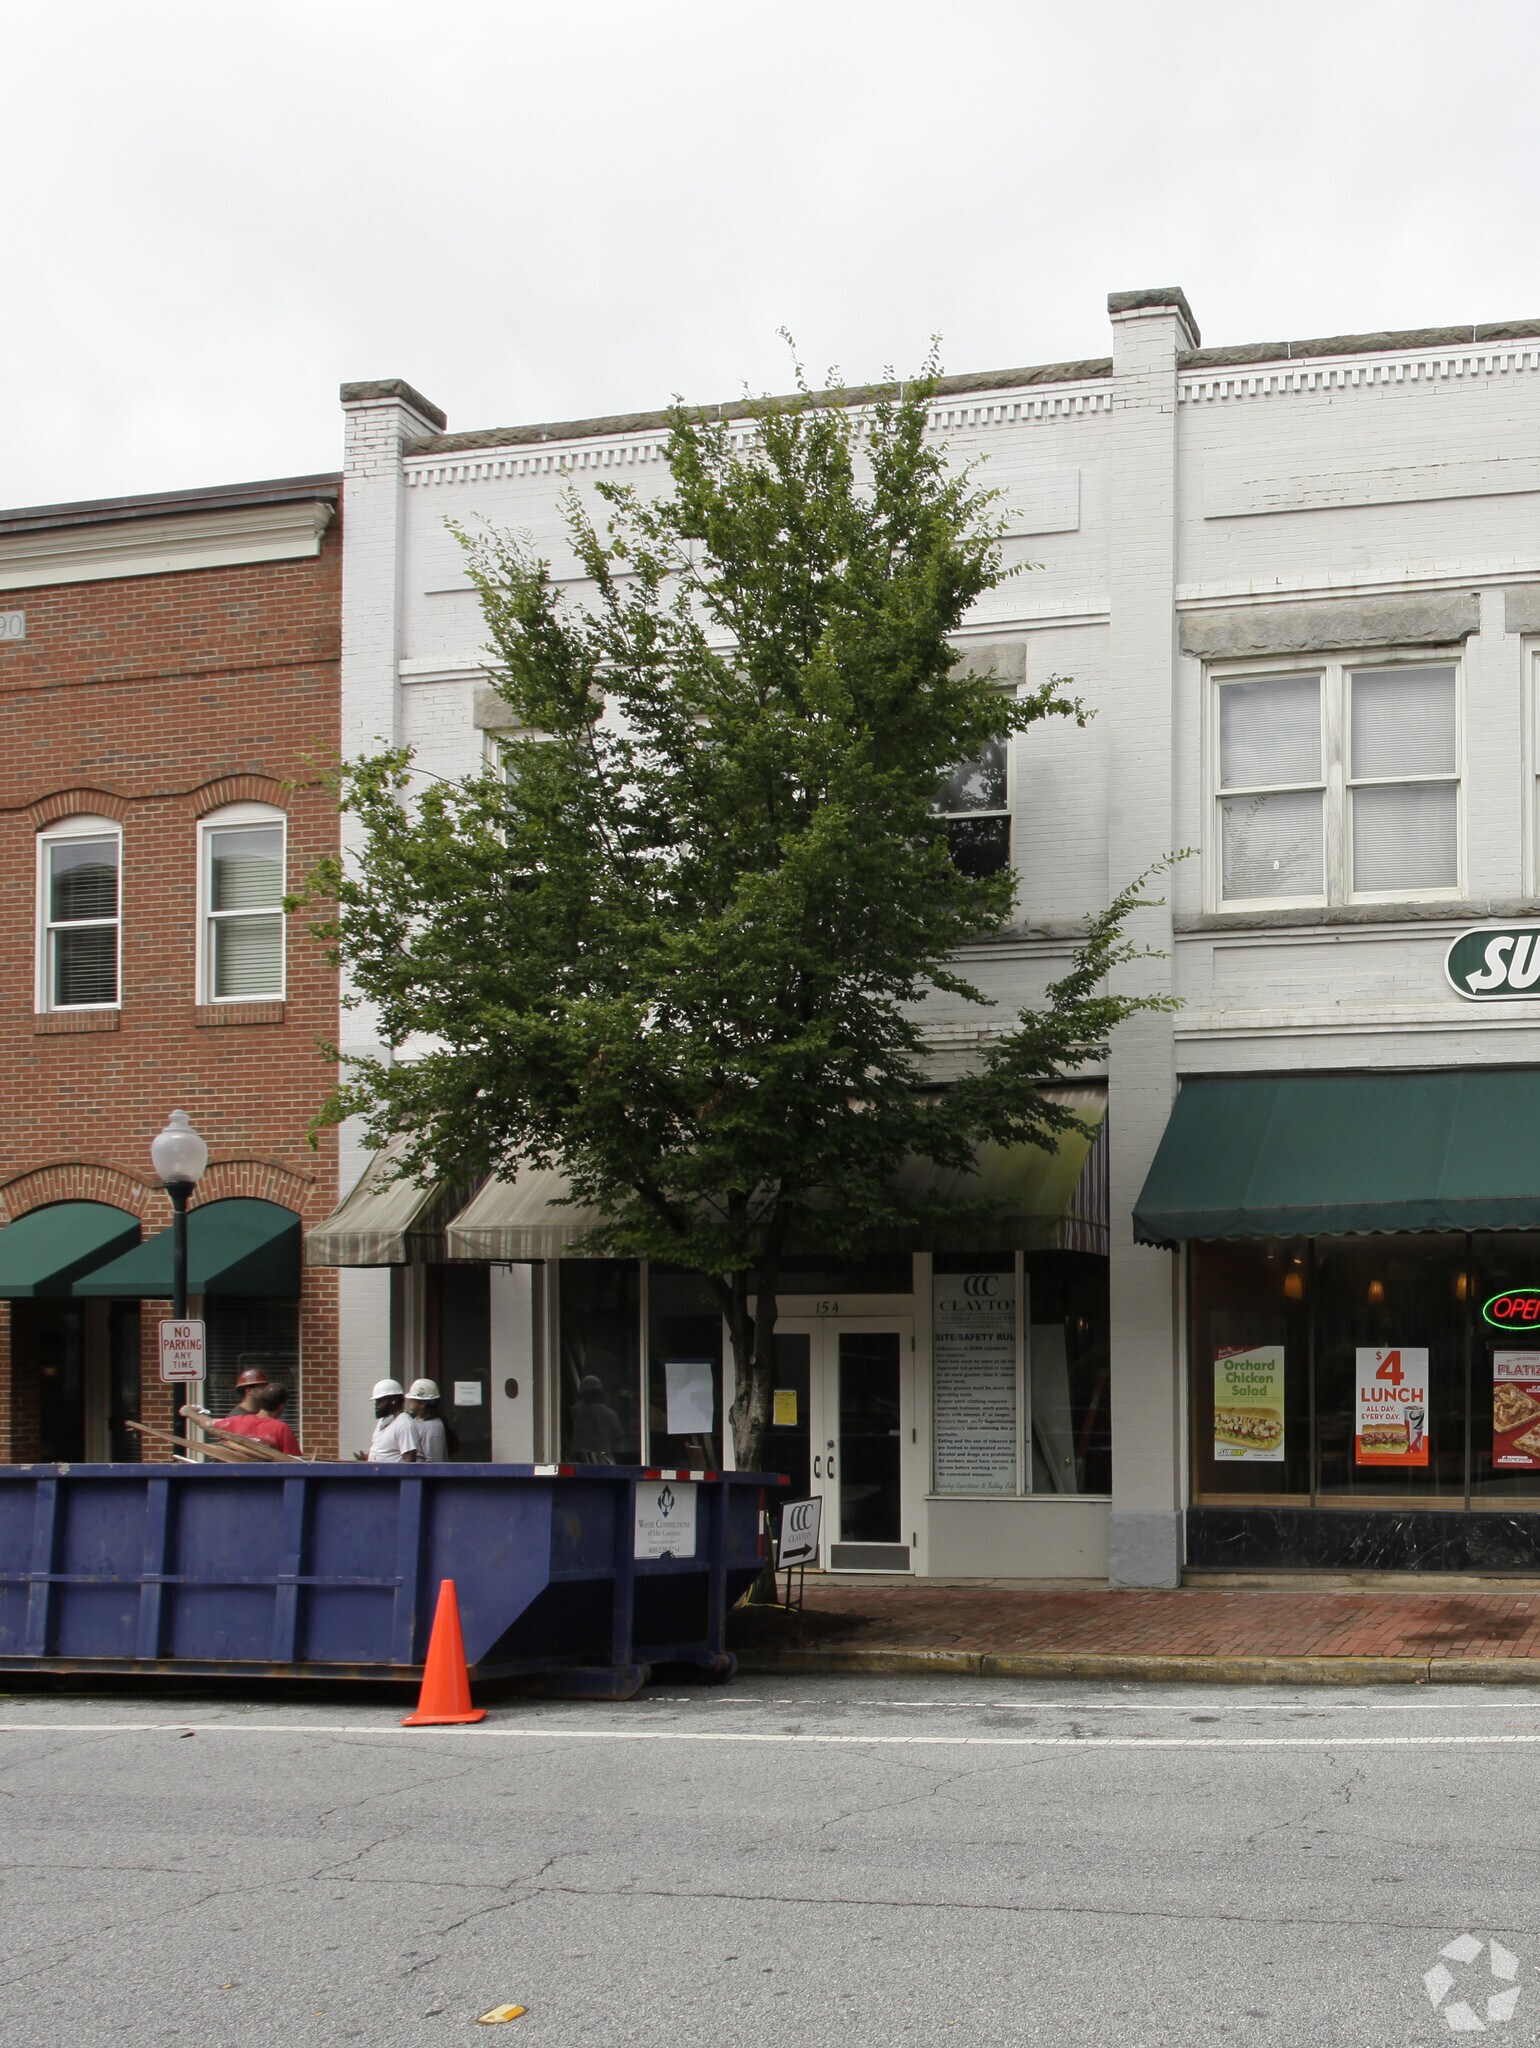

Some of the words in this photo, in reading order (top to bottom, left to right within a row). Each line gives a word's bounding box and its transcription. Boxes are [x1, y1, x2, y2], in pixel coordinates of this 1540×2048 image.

[816, 1301, 839, 1314] 154
[174, 1326, 190, 1338] NO
[935, 1333, 993, 1342] SITE/SAFETY
[164, 1339, 202, 1350] PARKING
[174, 1352, 191, 1360] ANY
[173, 1361, 193, 1369] TIME
[1224, 1359, 1275, 1371] Orchard
[1226, 1372, 1273, 1384] Chicken
[1232, 1385, 1267, 1396] Salad
[1361, 1388, 1423, 1402] LUNCH
[788, 1532, 811, 1543] CLAYTON
